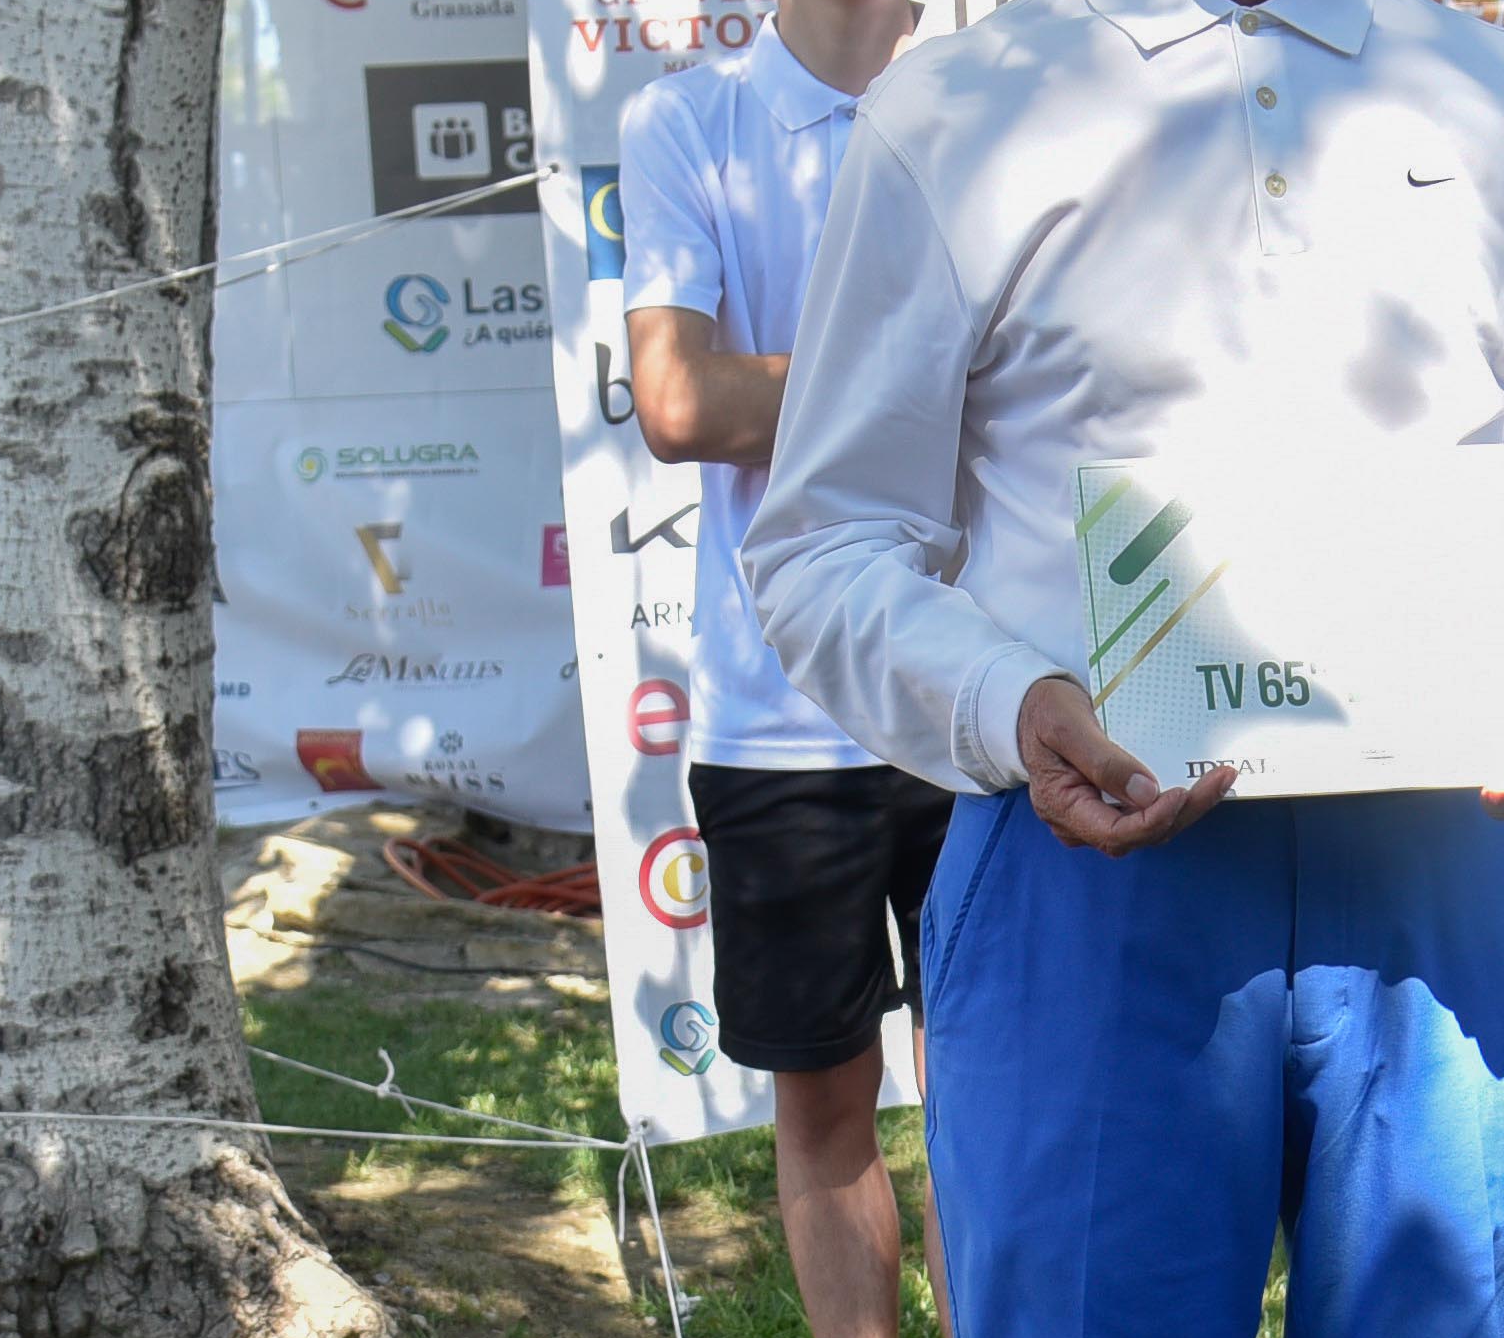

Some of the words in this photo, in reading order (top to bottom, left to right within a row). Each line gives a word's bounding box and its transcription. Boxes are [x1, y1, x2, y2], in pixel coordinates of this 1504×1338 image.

[570, 12, 768, 54] VICTO
[463, 277, 544, 315] Las
[336, 442, 480, 467] SOLUGRA
[1195, 662, 1245, 711] TV
